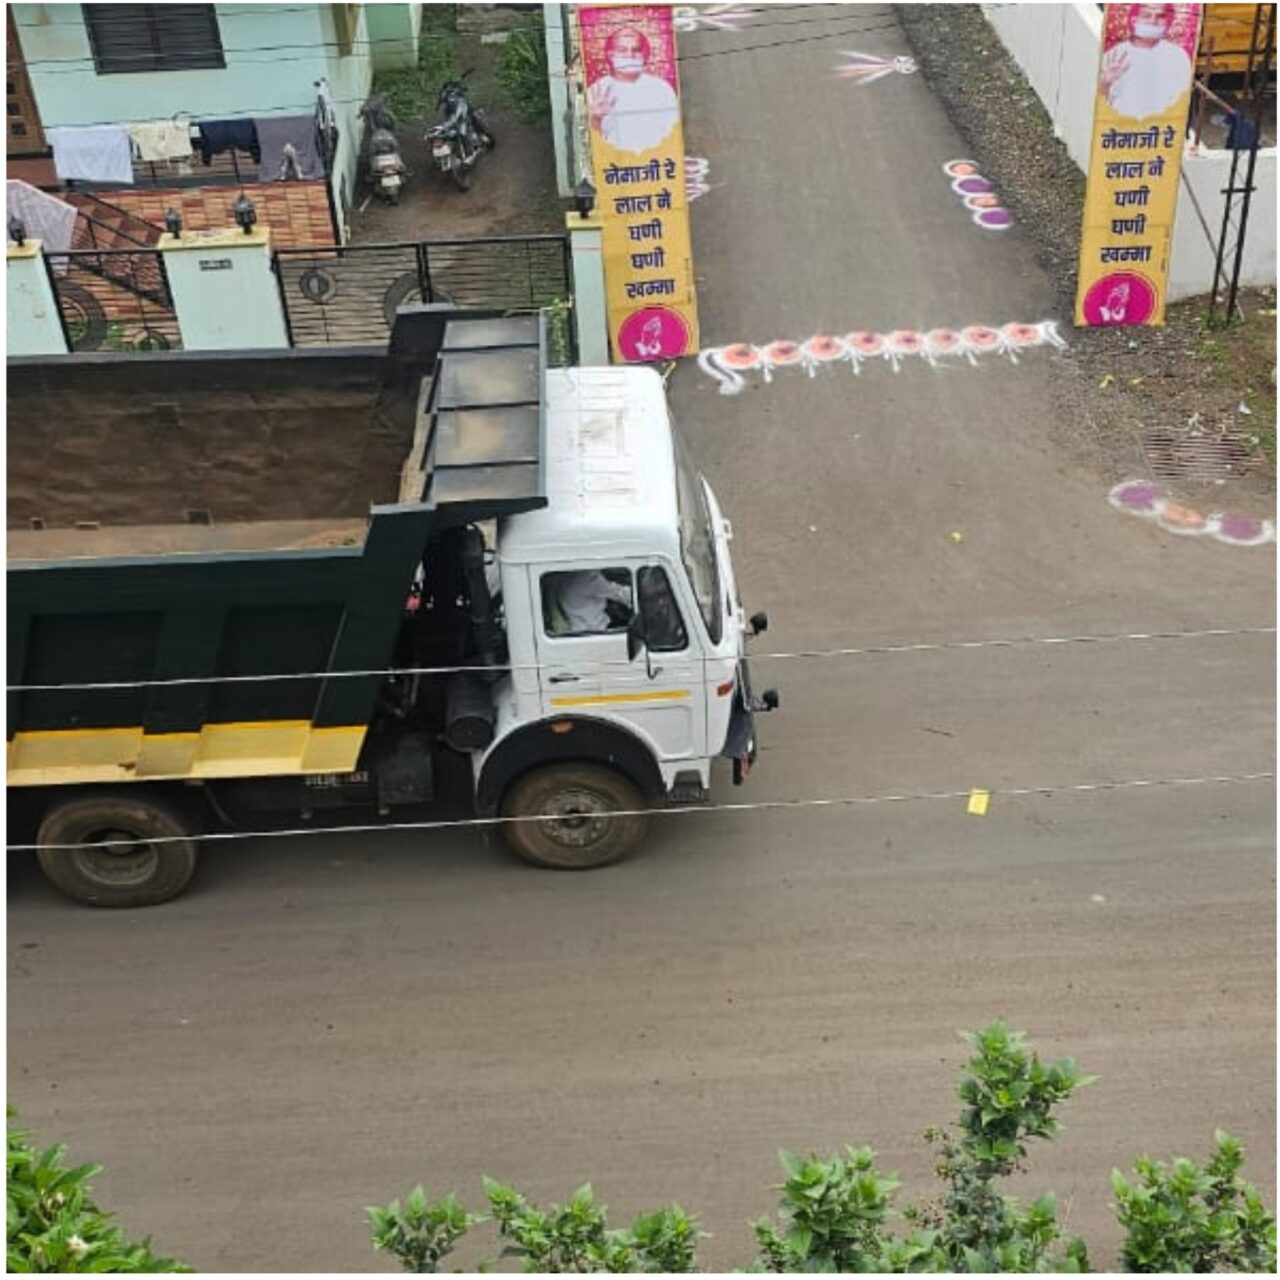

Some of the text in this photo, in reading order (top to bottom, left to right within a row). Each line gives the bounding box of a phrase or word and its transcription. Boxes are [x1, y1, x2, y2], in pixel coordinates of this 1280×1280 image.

[1101, 125, 1175, 149] नेमाजी रे
[603, 158, 677, 185] नेमाजी रे
[1105, 155, 1164, 179] लाल ने
[614, 188, 671, 214] लाल ने
[1111, 213, 1147, 235] घणी
[631, 246, 665, 269] घणी
[1100, 245, 1152, 263] खम्मा
[625, 279, 675, 299] खम्मा
